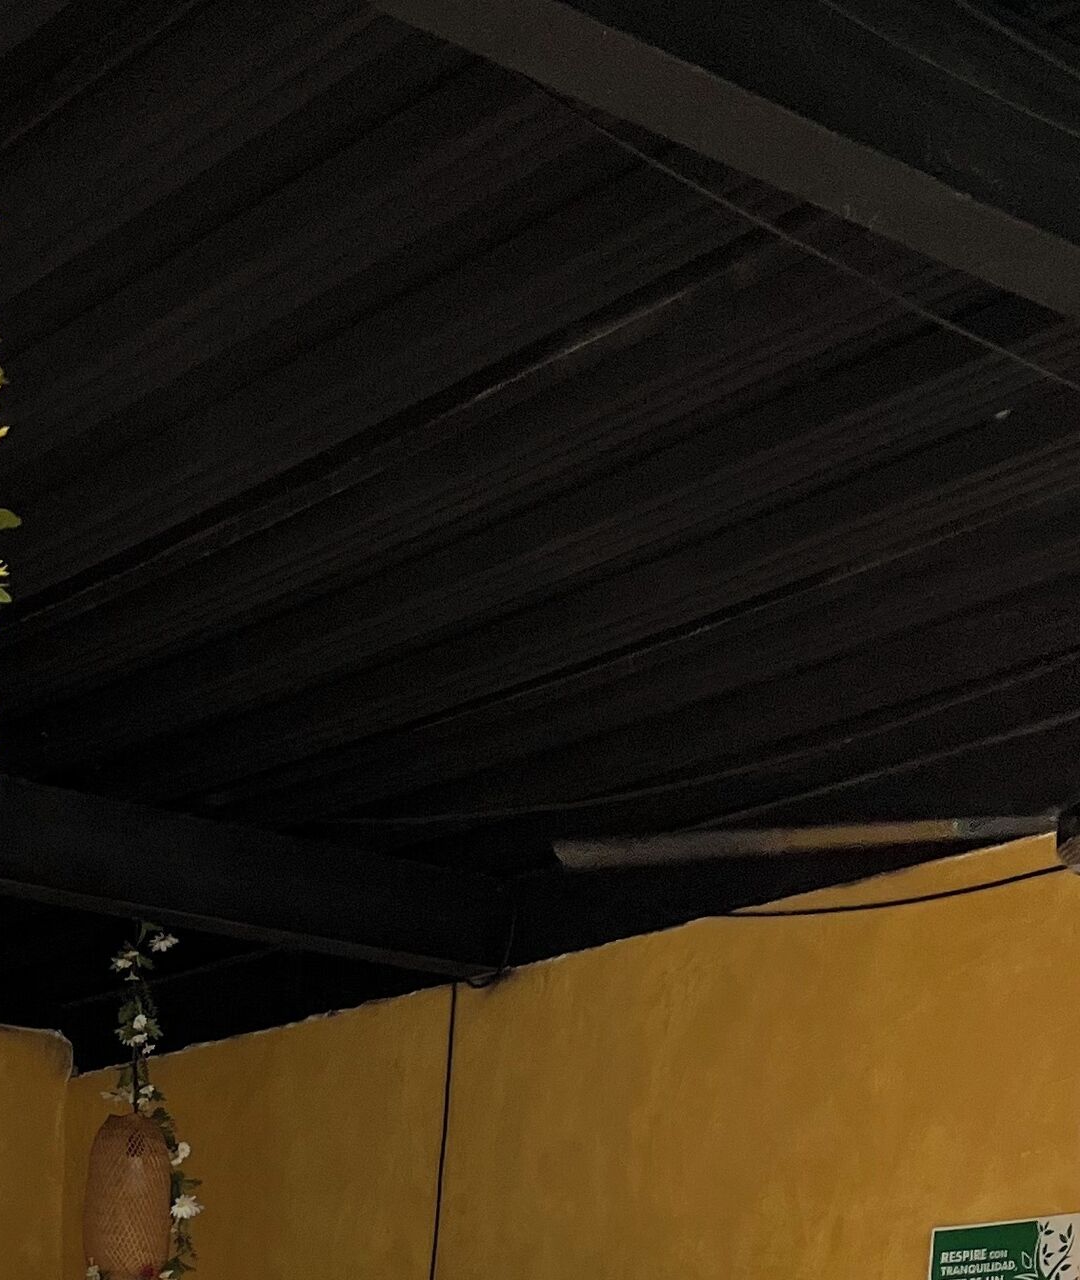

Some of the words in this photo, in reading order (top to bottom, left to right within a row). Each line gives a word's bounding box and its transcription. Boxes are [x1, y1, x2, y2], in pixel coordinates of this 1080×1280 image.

[940, 1248, 987, 1264] RESPIRE
[989, 1250, 1008, 1259] CON
[941, 1261, 1018, 1276] TRANQUILIDAD,
